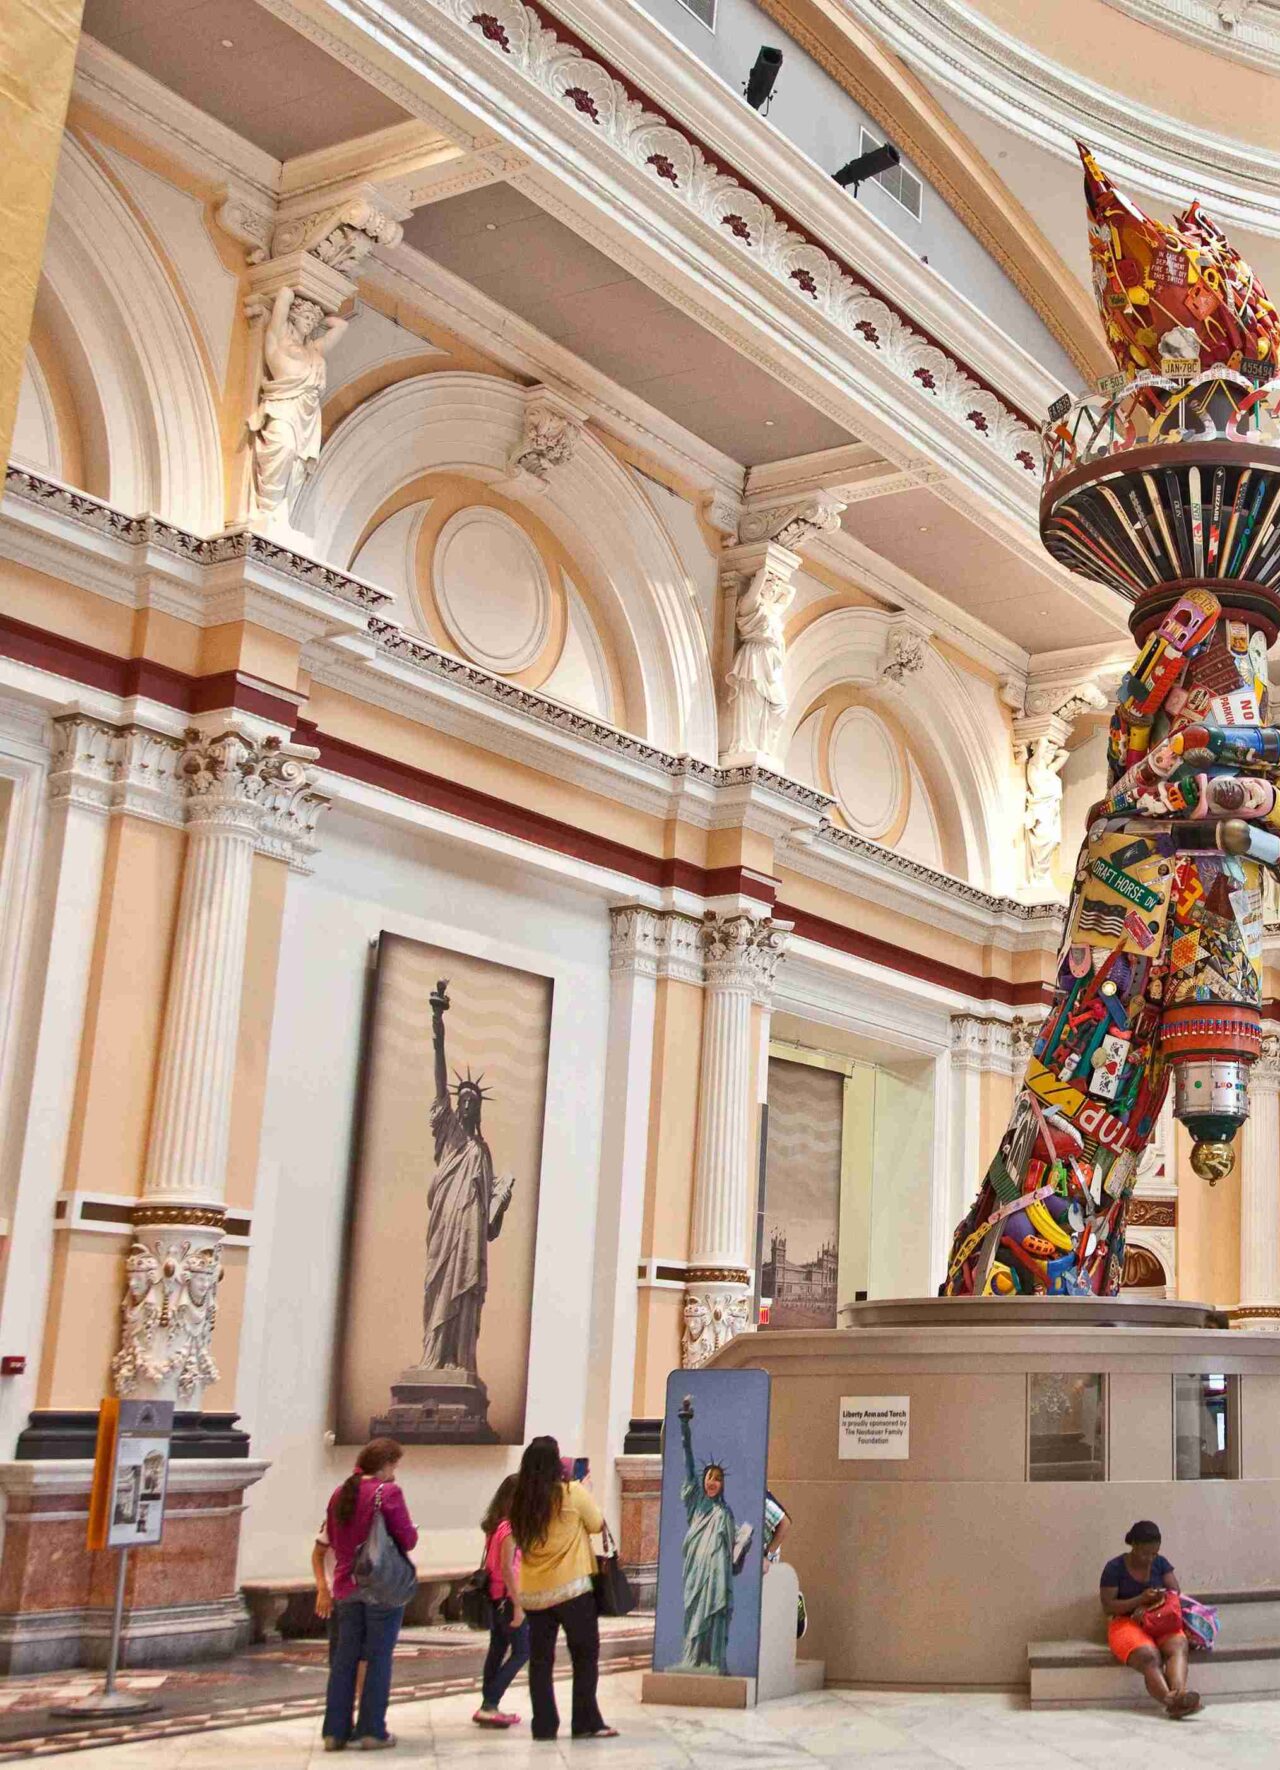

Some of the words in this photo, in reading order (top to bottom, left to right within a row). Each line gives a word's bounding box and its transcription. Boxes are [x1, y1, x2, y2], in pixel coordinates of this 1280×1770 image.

[1240, 699, 1255, 721] NO
[1092, 861, 1118, 885] DRAFT
[1113, 875, 1146, 903] HORSE
[843, 1410, 863, 1420] Liberty
[877, 1410, 889, 1418] and
[889, 1410, 907, 1418] Torch
